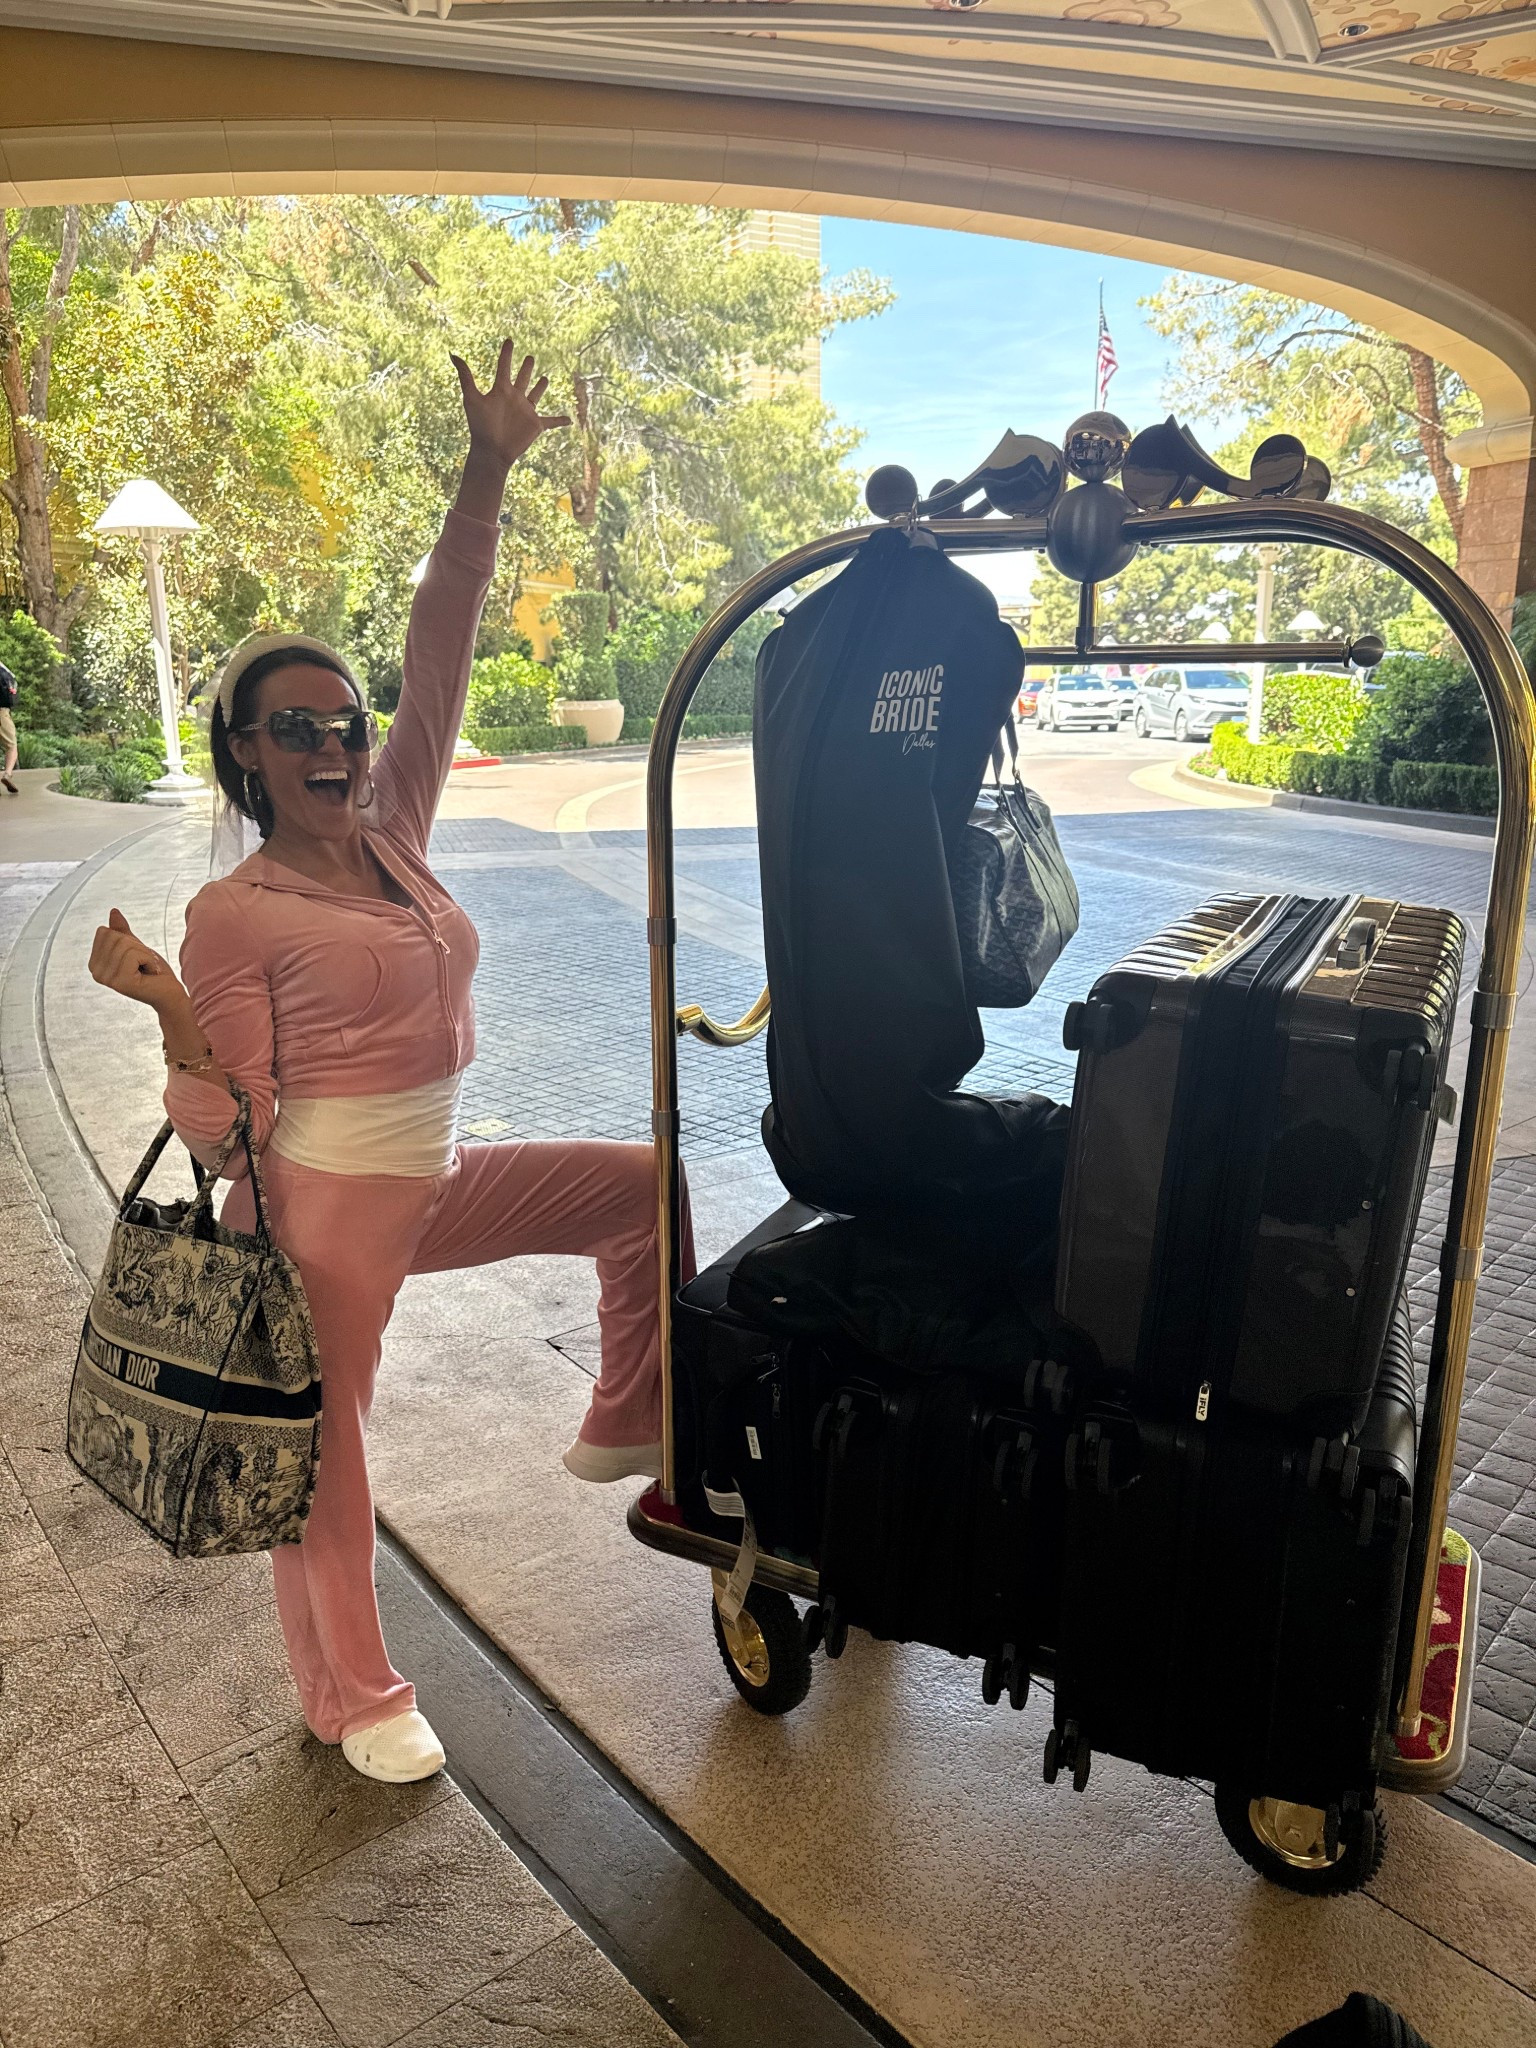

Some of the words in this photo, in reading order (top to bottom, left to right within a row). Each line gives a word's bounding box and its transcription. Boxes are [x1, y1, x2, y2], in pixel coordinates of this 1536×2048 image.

[877, 664, 944, 699] ICONIC
[869, 696, 942, 733] BRIDE
[902, 732, 936, 756] Dallas
[125, 1354, 160, 1391] DIOR
